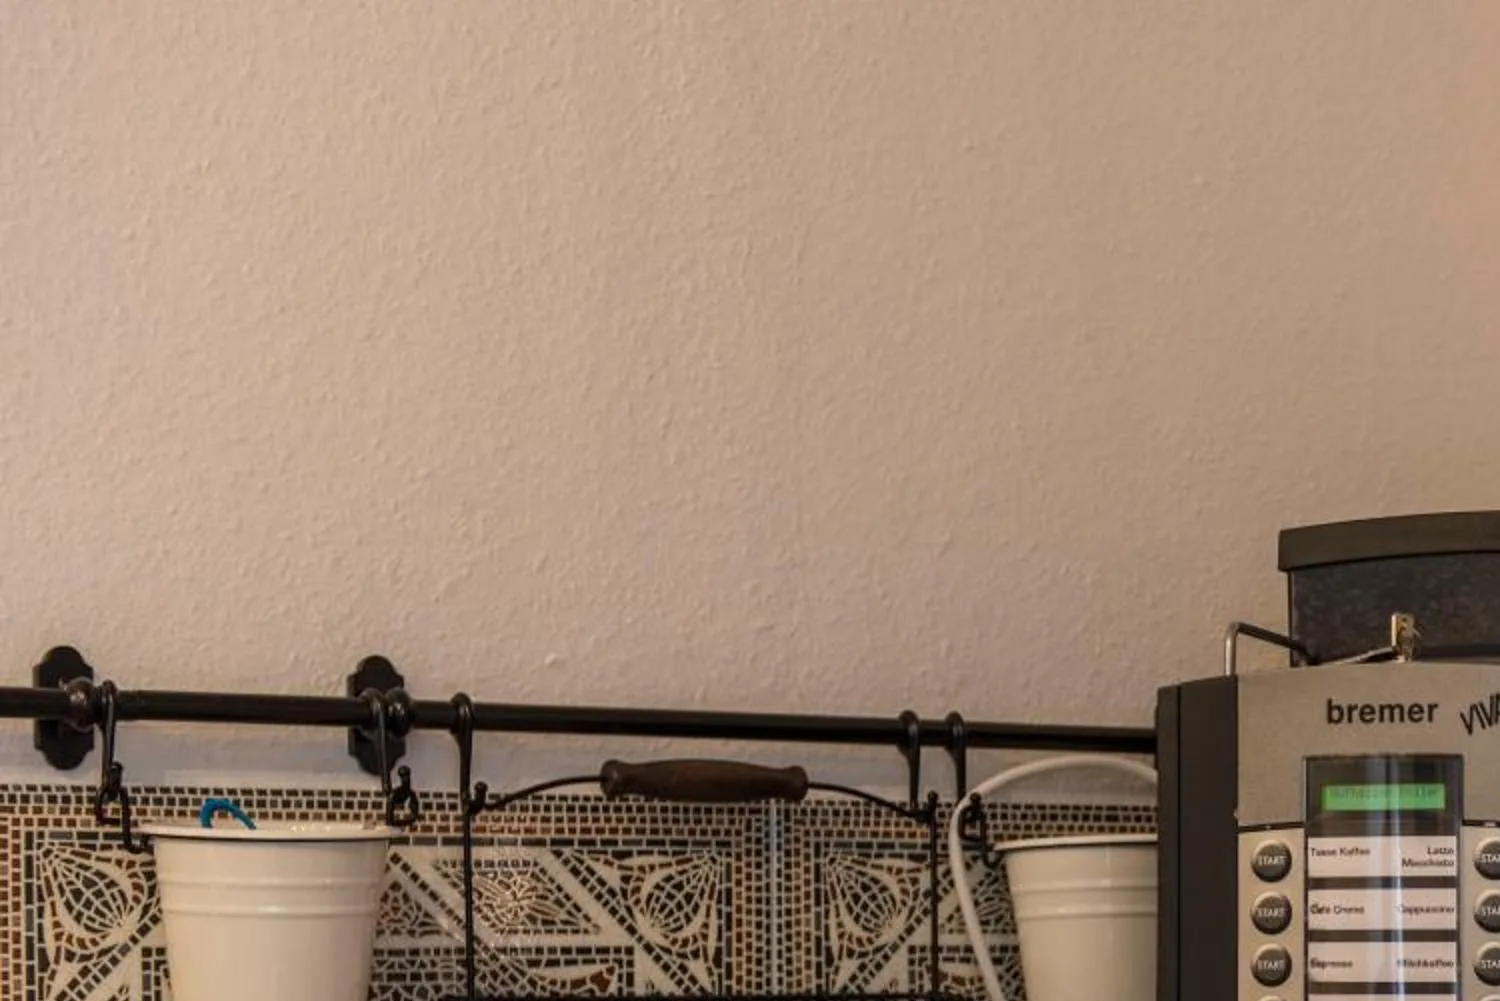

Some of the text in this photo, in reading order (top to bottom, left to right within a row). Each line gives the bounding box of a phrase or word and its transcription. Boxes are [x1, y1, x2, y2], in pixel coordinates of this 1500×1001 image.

[1326, 698, 1439, 724] bremer
[1427, 846, 1455, 855] Latte
[1257, 855, 1286, 866] START
[1257, 907, 1286, 918] START
[1257, 959, 1286, 970] START
